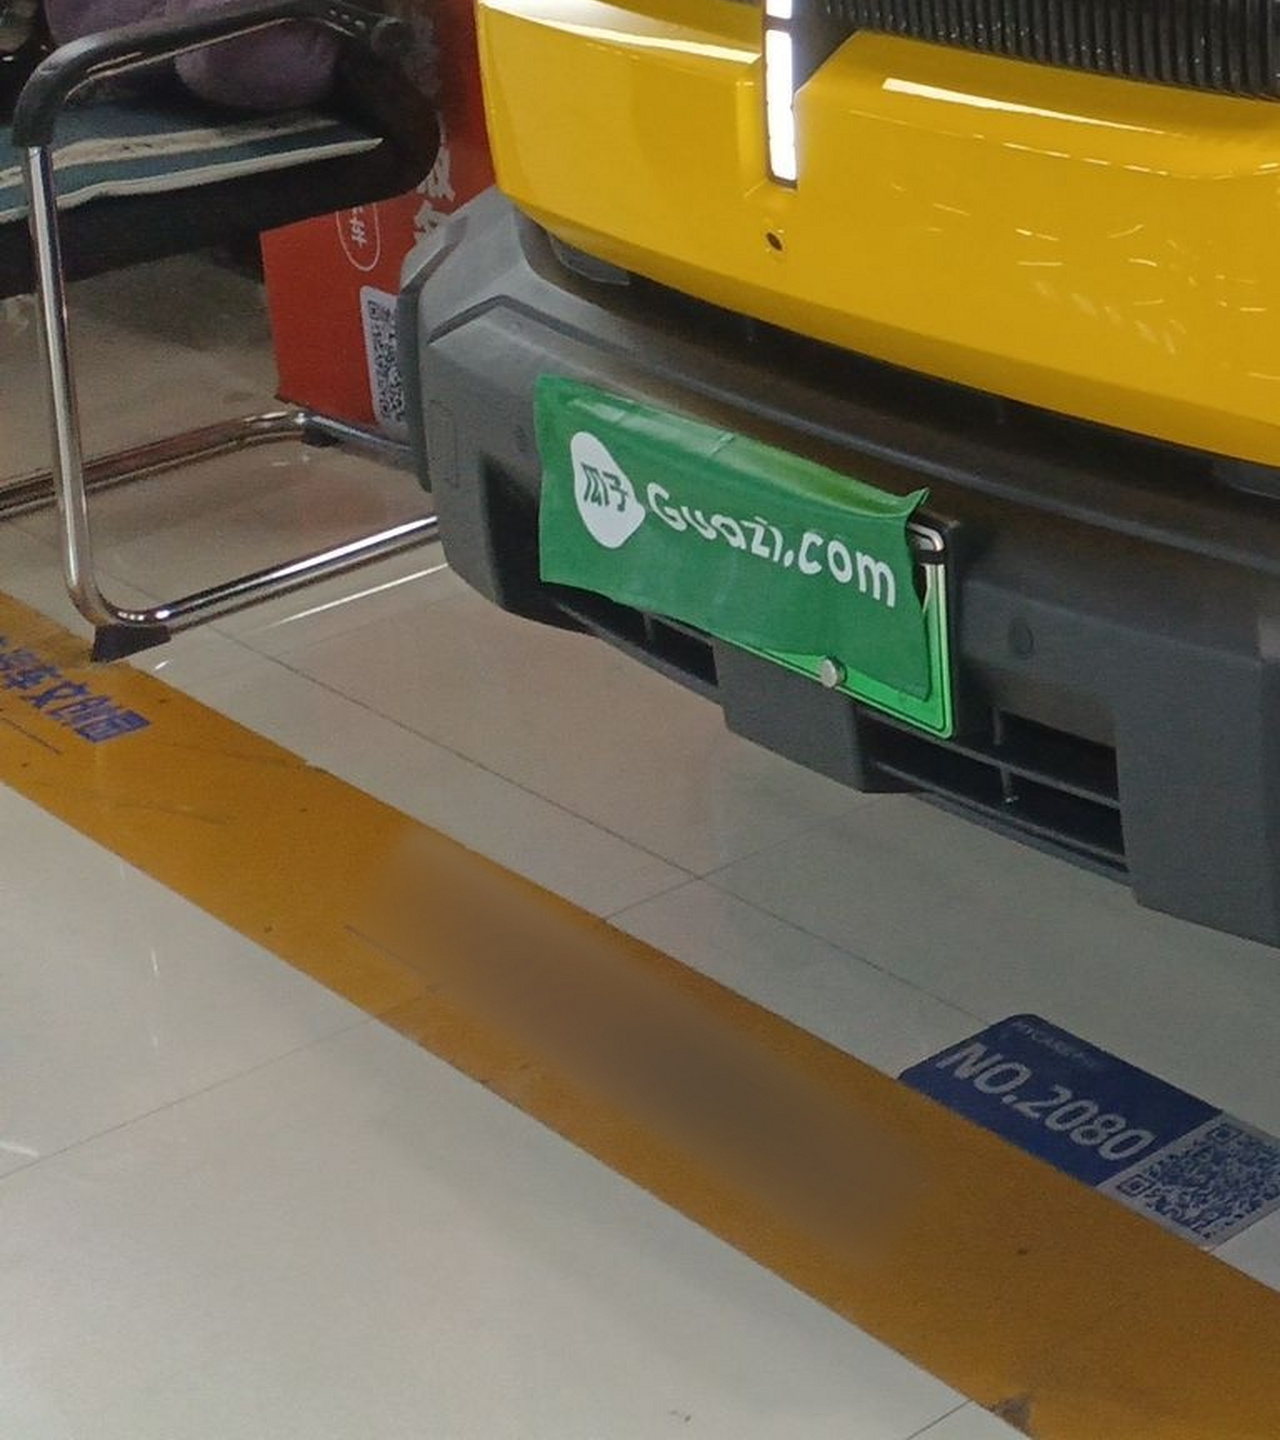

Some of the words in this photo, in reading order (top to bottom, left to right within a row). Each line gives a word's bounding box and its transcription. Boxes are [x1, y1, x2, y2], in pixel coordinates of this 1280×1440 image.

[580, 462, 629, 512] 瓜子
[646, 481, 896, 608] Guazi.com
[935, 1042, 1157, 1161] NO.2080
